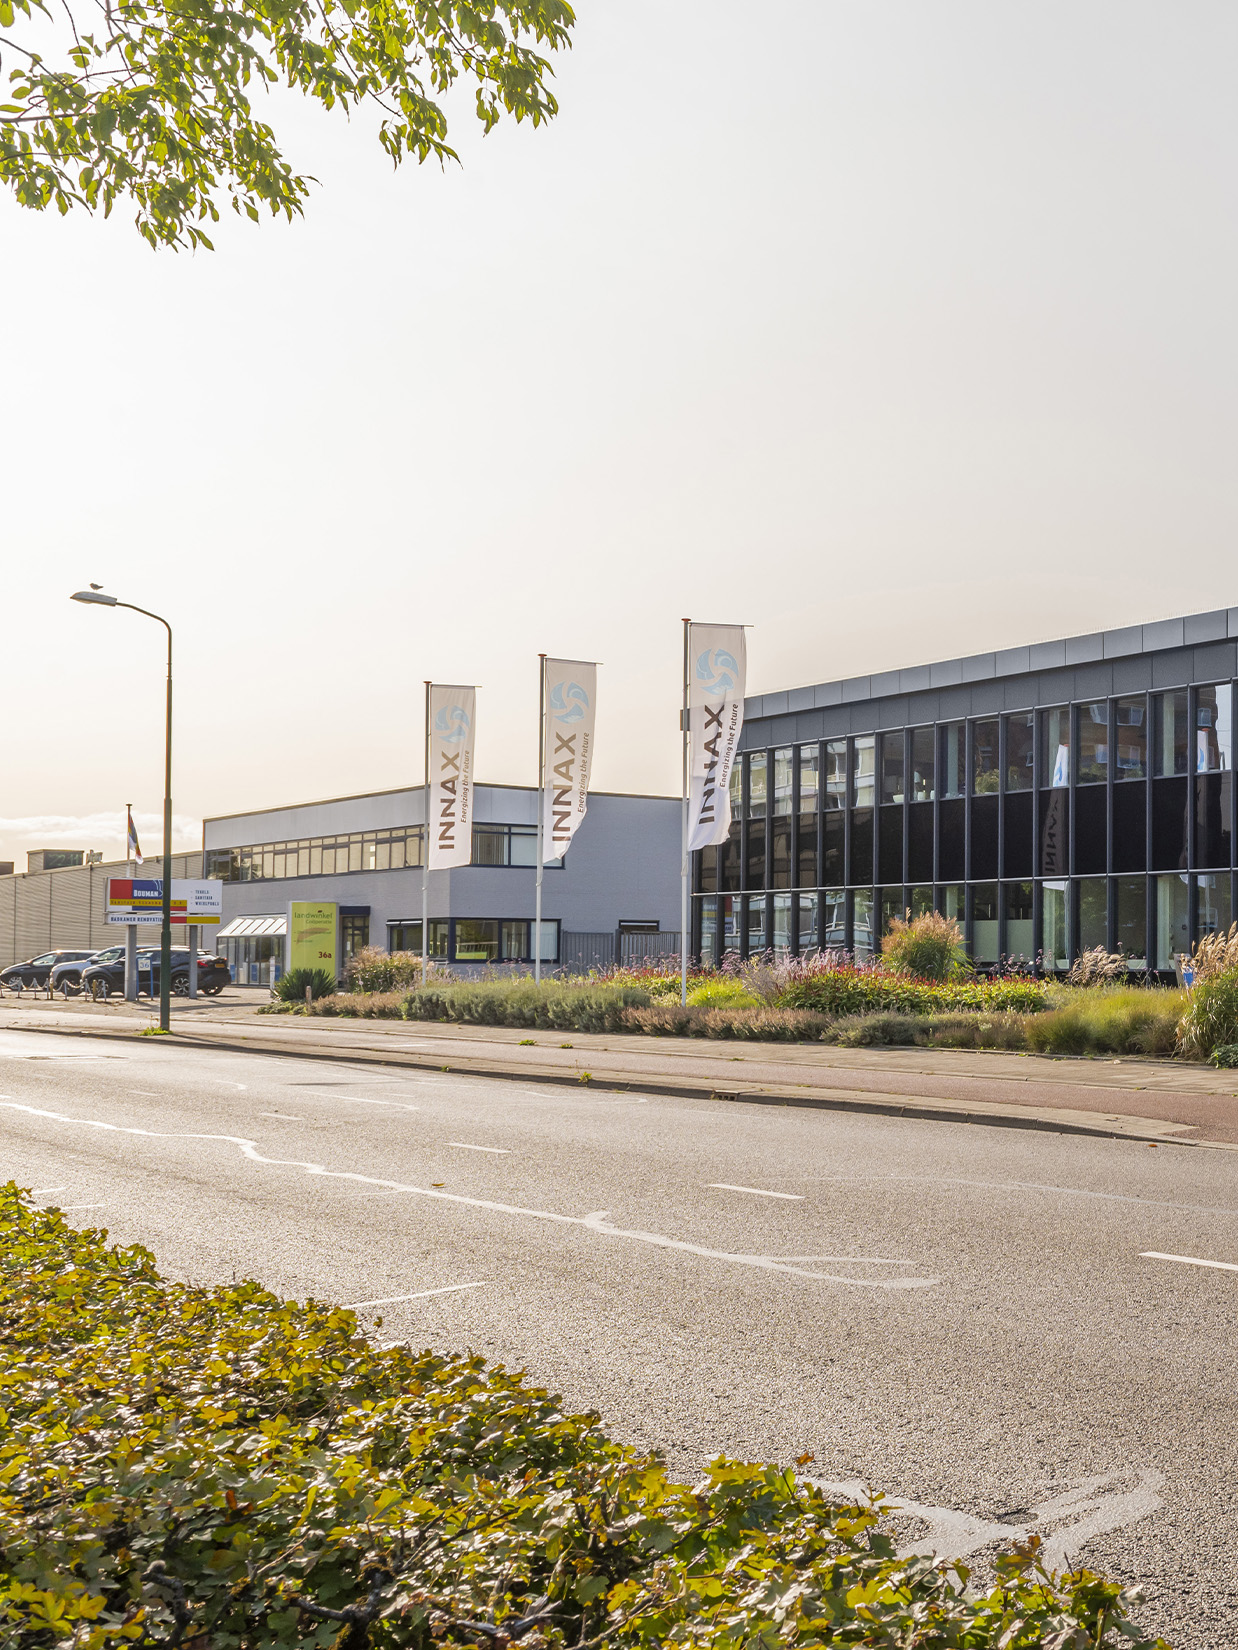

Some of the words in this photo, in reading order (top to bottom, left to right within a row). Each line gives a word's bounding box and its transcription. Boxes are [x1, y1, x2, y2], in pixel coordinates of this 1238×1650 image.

[729, 703, 739, 732] Future
[581, 732, 590, 758] Future
[728, 732, 736, 746] the
[699, 704, 725, 825] INNAX
[719, 746, 734, 788] Energizing
[438, 750, 460, 850] INNAX
[552, 731, 577, 842] INNAX
[577, 772, 588, 813] Energizing
[460, 787, 470, 824] Energizing
[294, 911, 333, 919] landwinkel
[318, 951, 332, 959] 36a
